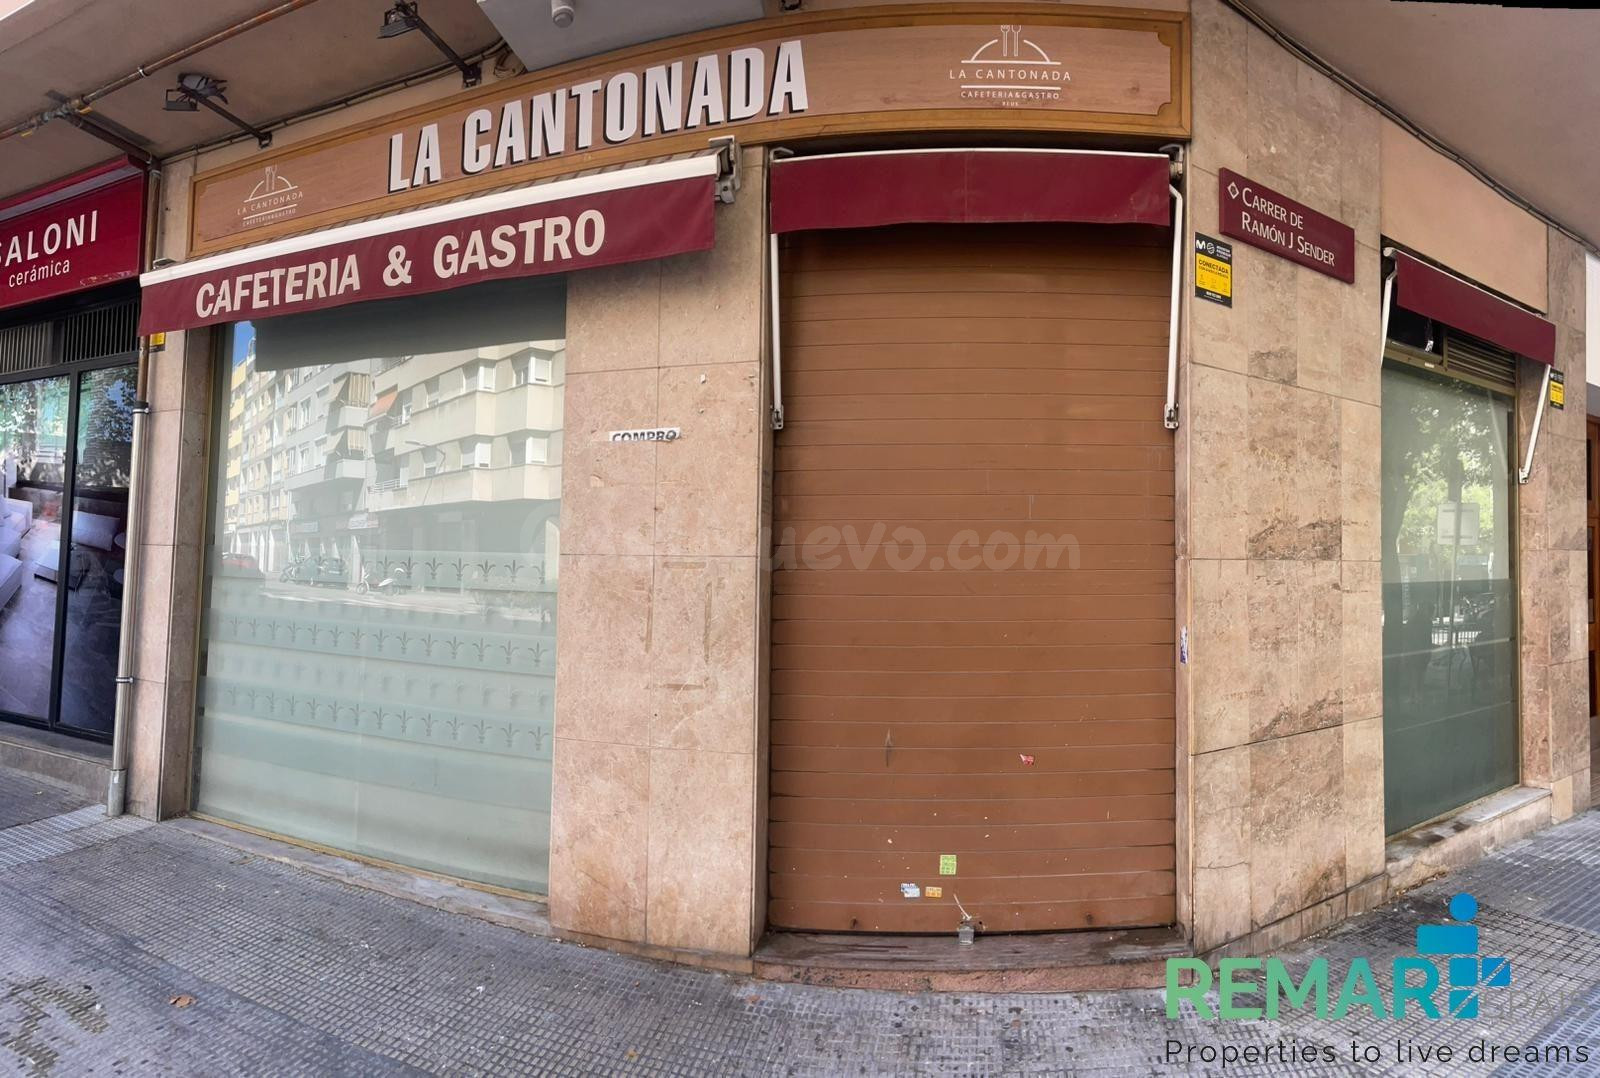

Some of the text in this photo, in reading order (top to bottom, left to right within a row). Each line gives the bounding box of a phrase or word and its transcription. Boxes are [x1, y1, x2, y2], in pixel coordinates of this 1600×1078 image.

[949, 69, 1071, 81] LA CANTONADA
[960, 90, 1060, 100] CAFETERIA&GASTRO
[389, 40, 809, 193] LA CANTONADA
[1241, 187, 1304, 230] CARRER DE
[1241, 211, 1336, 267] RAMÓN J SENDER
[8, 259, 70, 288] cerámica
[196, 209, 606, 319] CAFETERIA & GASTRO
